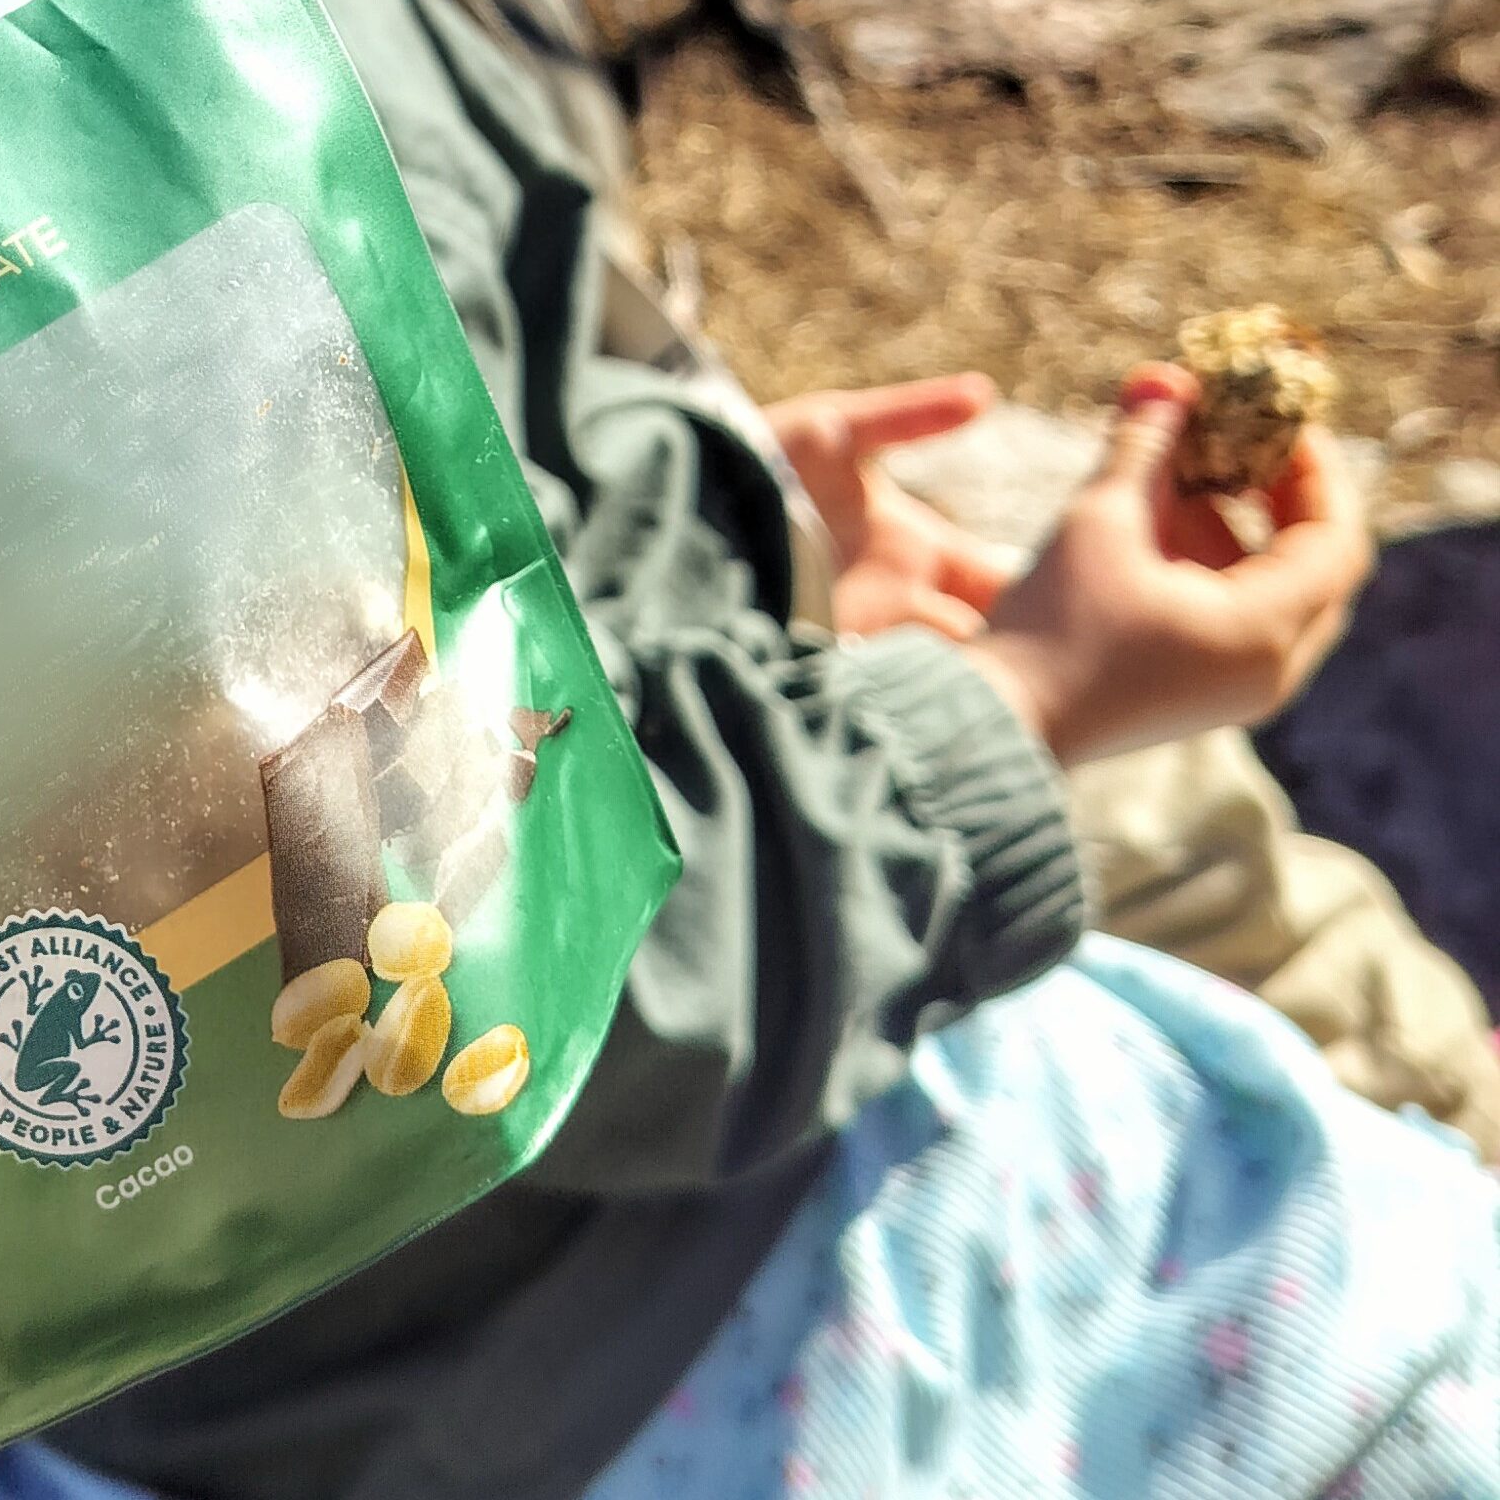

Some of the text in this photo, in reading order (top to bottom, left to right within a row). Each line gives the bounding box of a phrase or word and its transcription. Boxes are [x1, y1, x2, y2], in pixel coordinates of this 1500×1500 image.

[30, 936, 153, 1002] ALLIANCE
[101, 1115, 125, 1136] &
[119, 1022, 168, 1121] NATURE
[95, 1145, 194, 1209] Cacao
